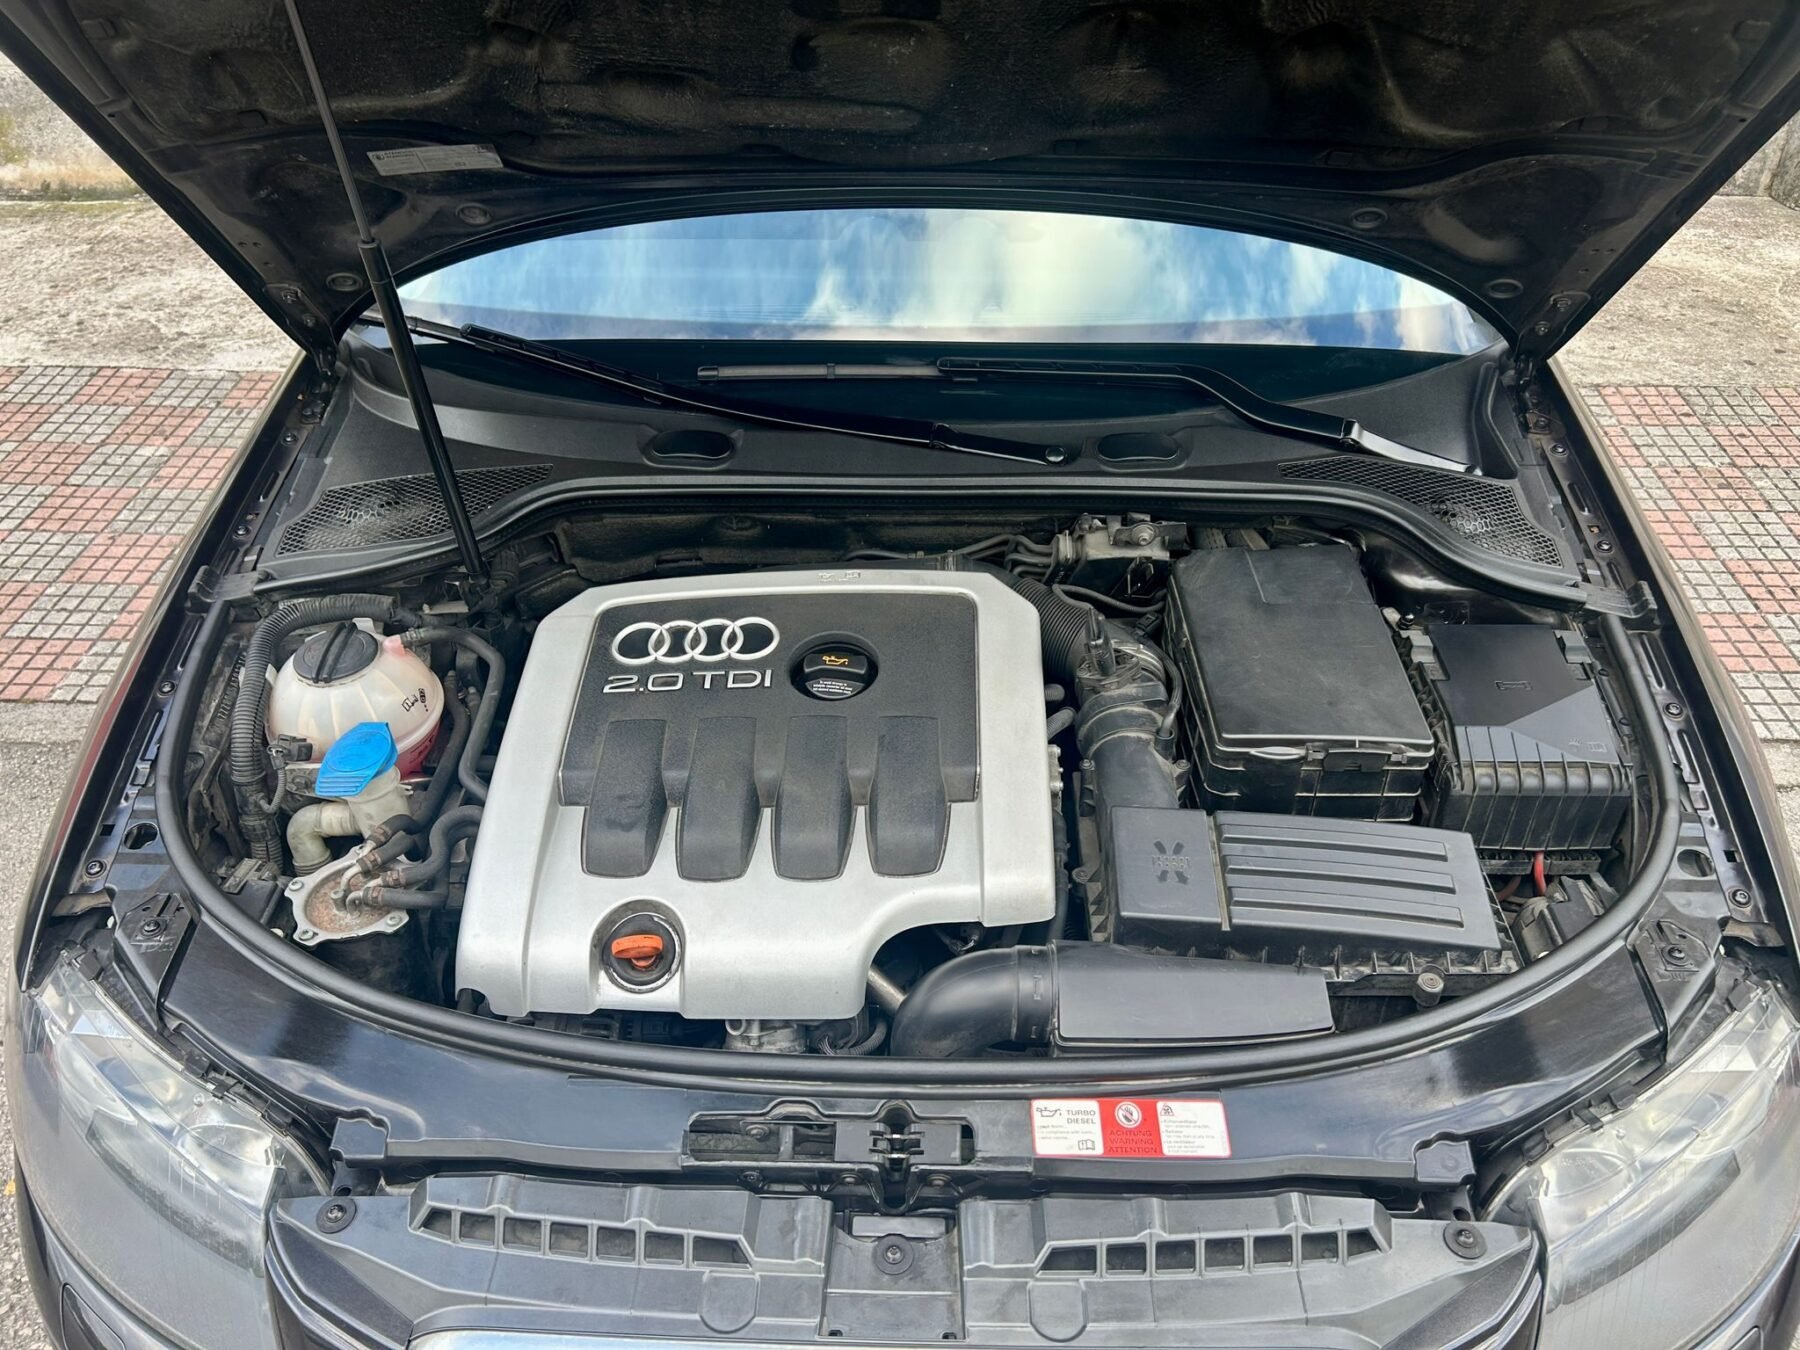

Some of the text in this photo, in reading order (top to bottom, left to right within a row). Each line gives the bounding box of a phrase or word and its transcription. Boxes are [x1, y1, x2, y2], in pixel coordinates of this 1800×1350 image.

[603, 669, 772, 693] 2.0 TDI
[1066, 1109, 1096, 1117] TURBO
